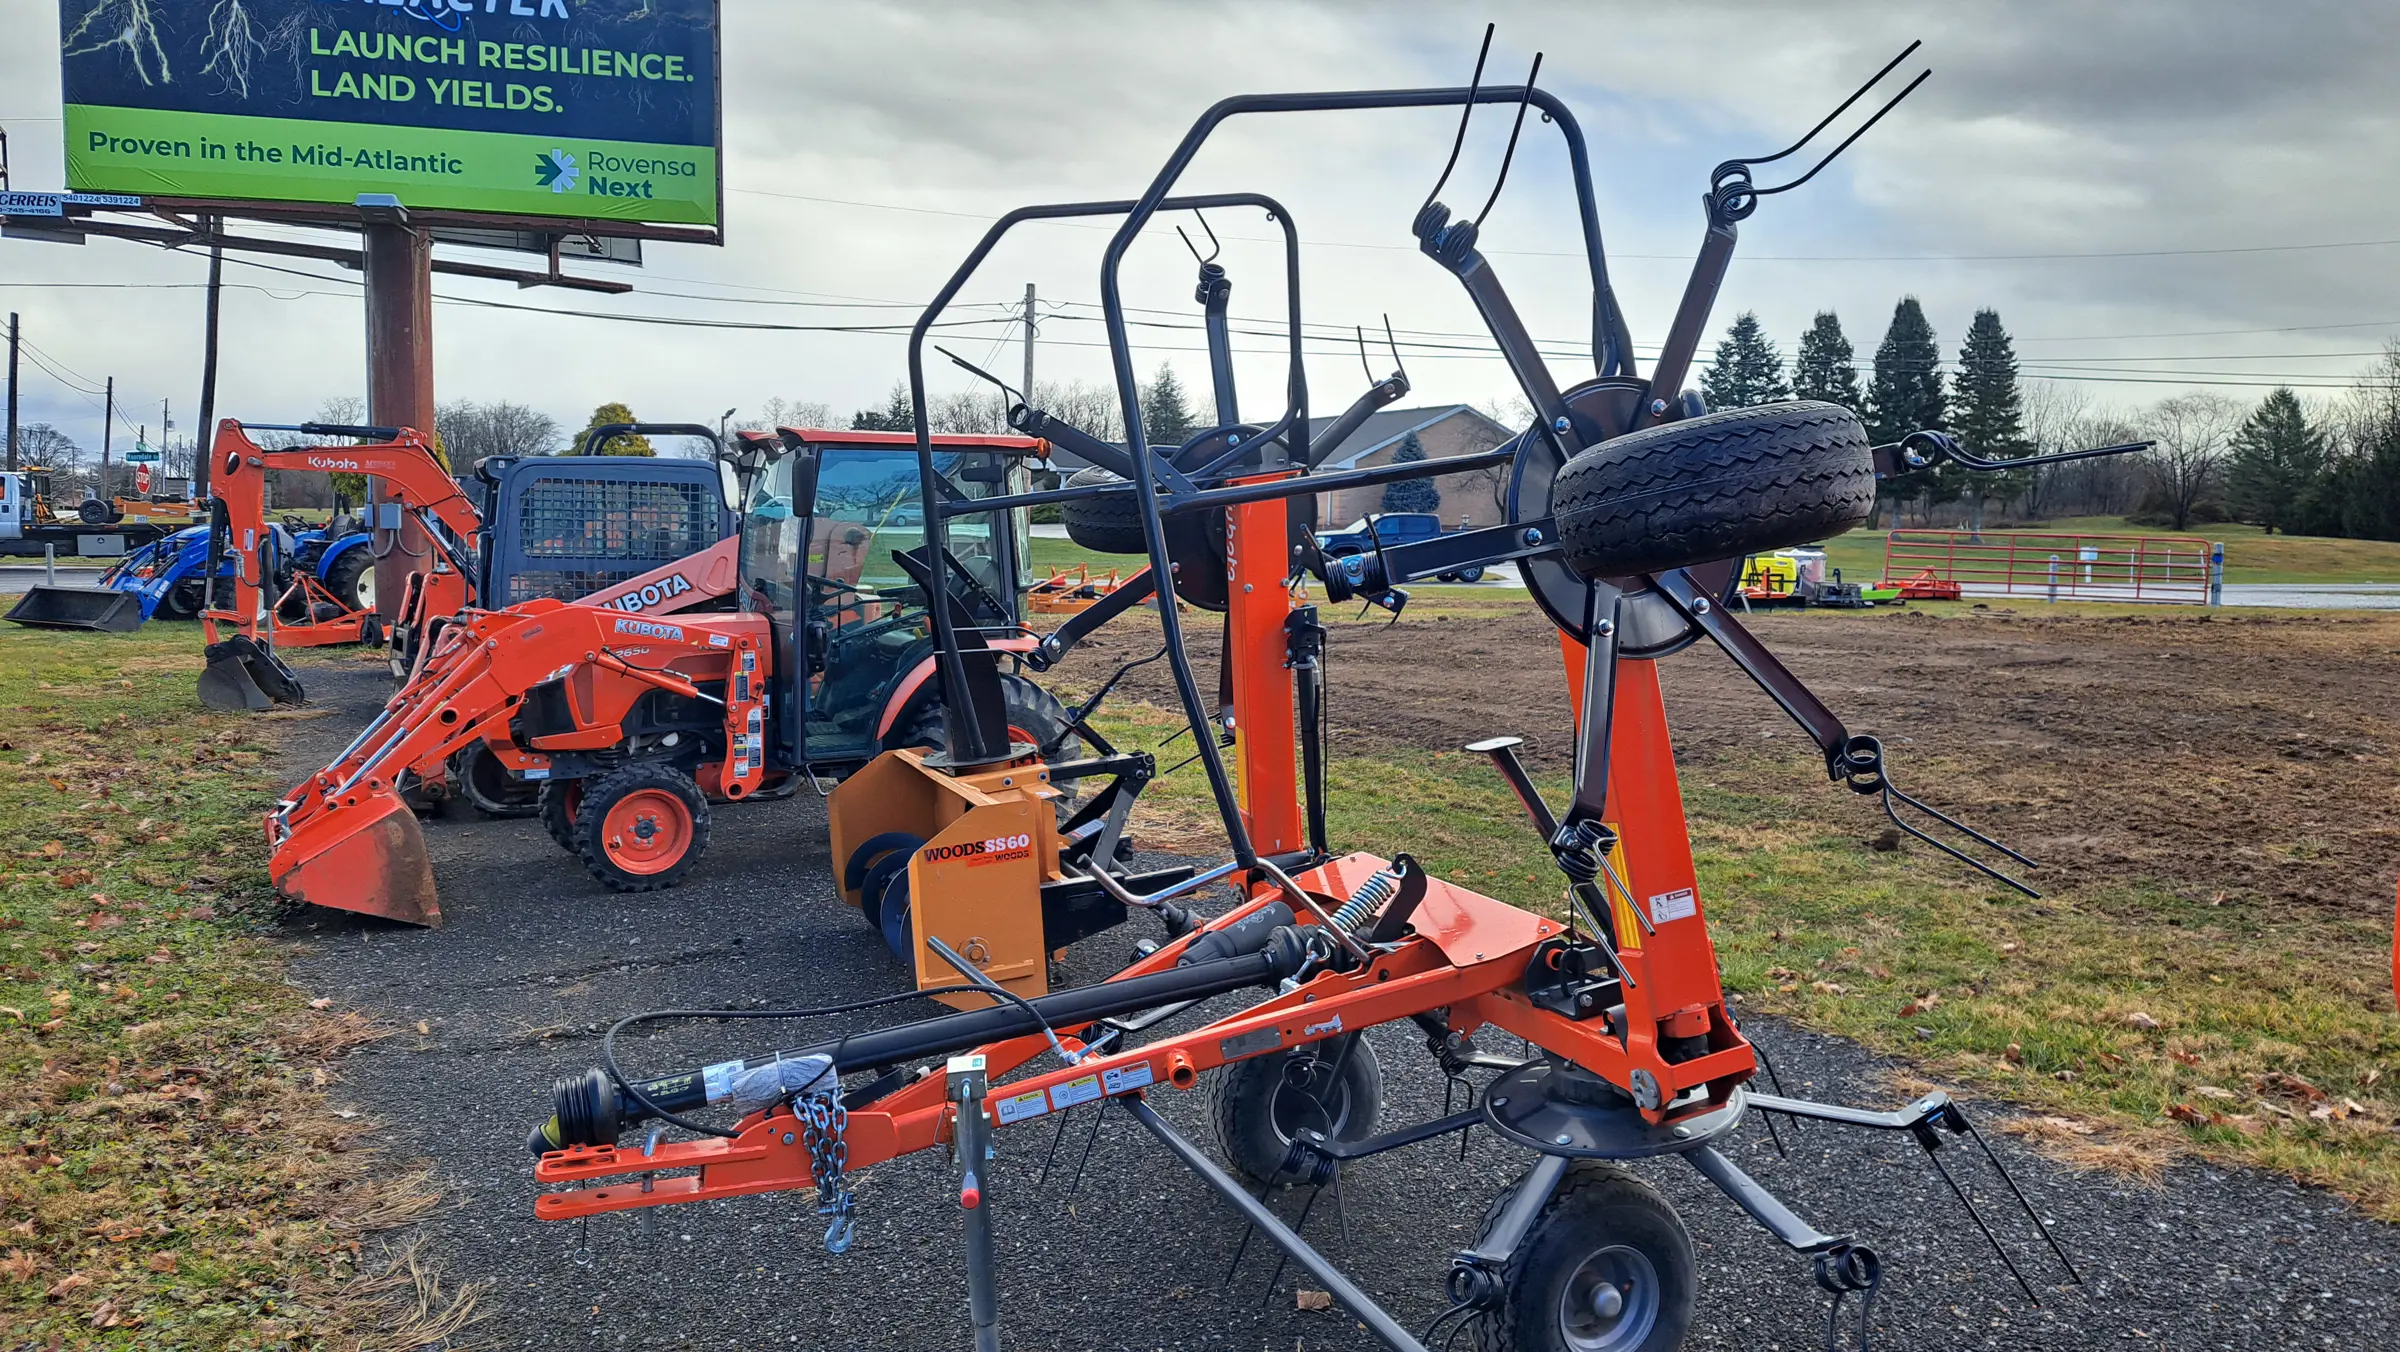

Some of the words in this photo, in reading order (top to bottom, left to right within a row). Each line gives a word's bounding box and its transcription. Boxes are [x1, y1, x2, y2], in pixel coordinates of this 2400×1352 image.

[310, 27, 466, 65] LAUNCH
[479, 40, 694, 82] RESILIENCE.
[311, 69, 416, 102] LAND
[426, 77, 563, 113] YIELDS.
[88, 131, 190, 158] Proven
[200, 136, 226, 160] in
[235, 141, 283, 163] the
[292, 143, 463, 175] Mid-Atlantic
[588, 151, 696, 177] Rovensa
[588, 176, 653, 199] Next
[308, 455, 358, 469] Kubota
[137, 472, 150, 485] STOP
[1226, 502, 1238, 582] ubota
[602, 574, 692, 613] UBOTA
[615, 619, 684, 642] KUBOTA
[924, 840, 986, 863] WOODS
[985, 833, 1030, 853] SS60
[994, 849, 1030, 862] WOODS
